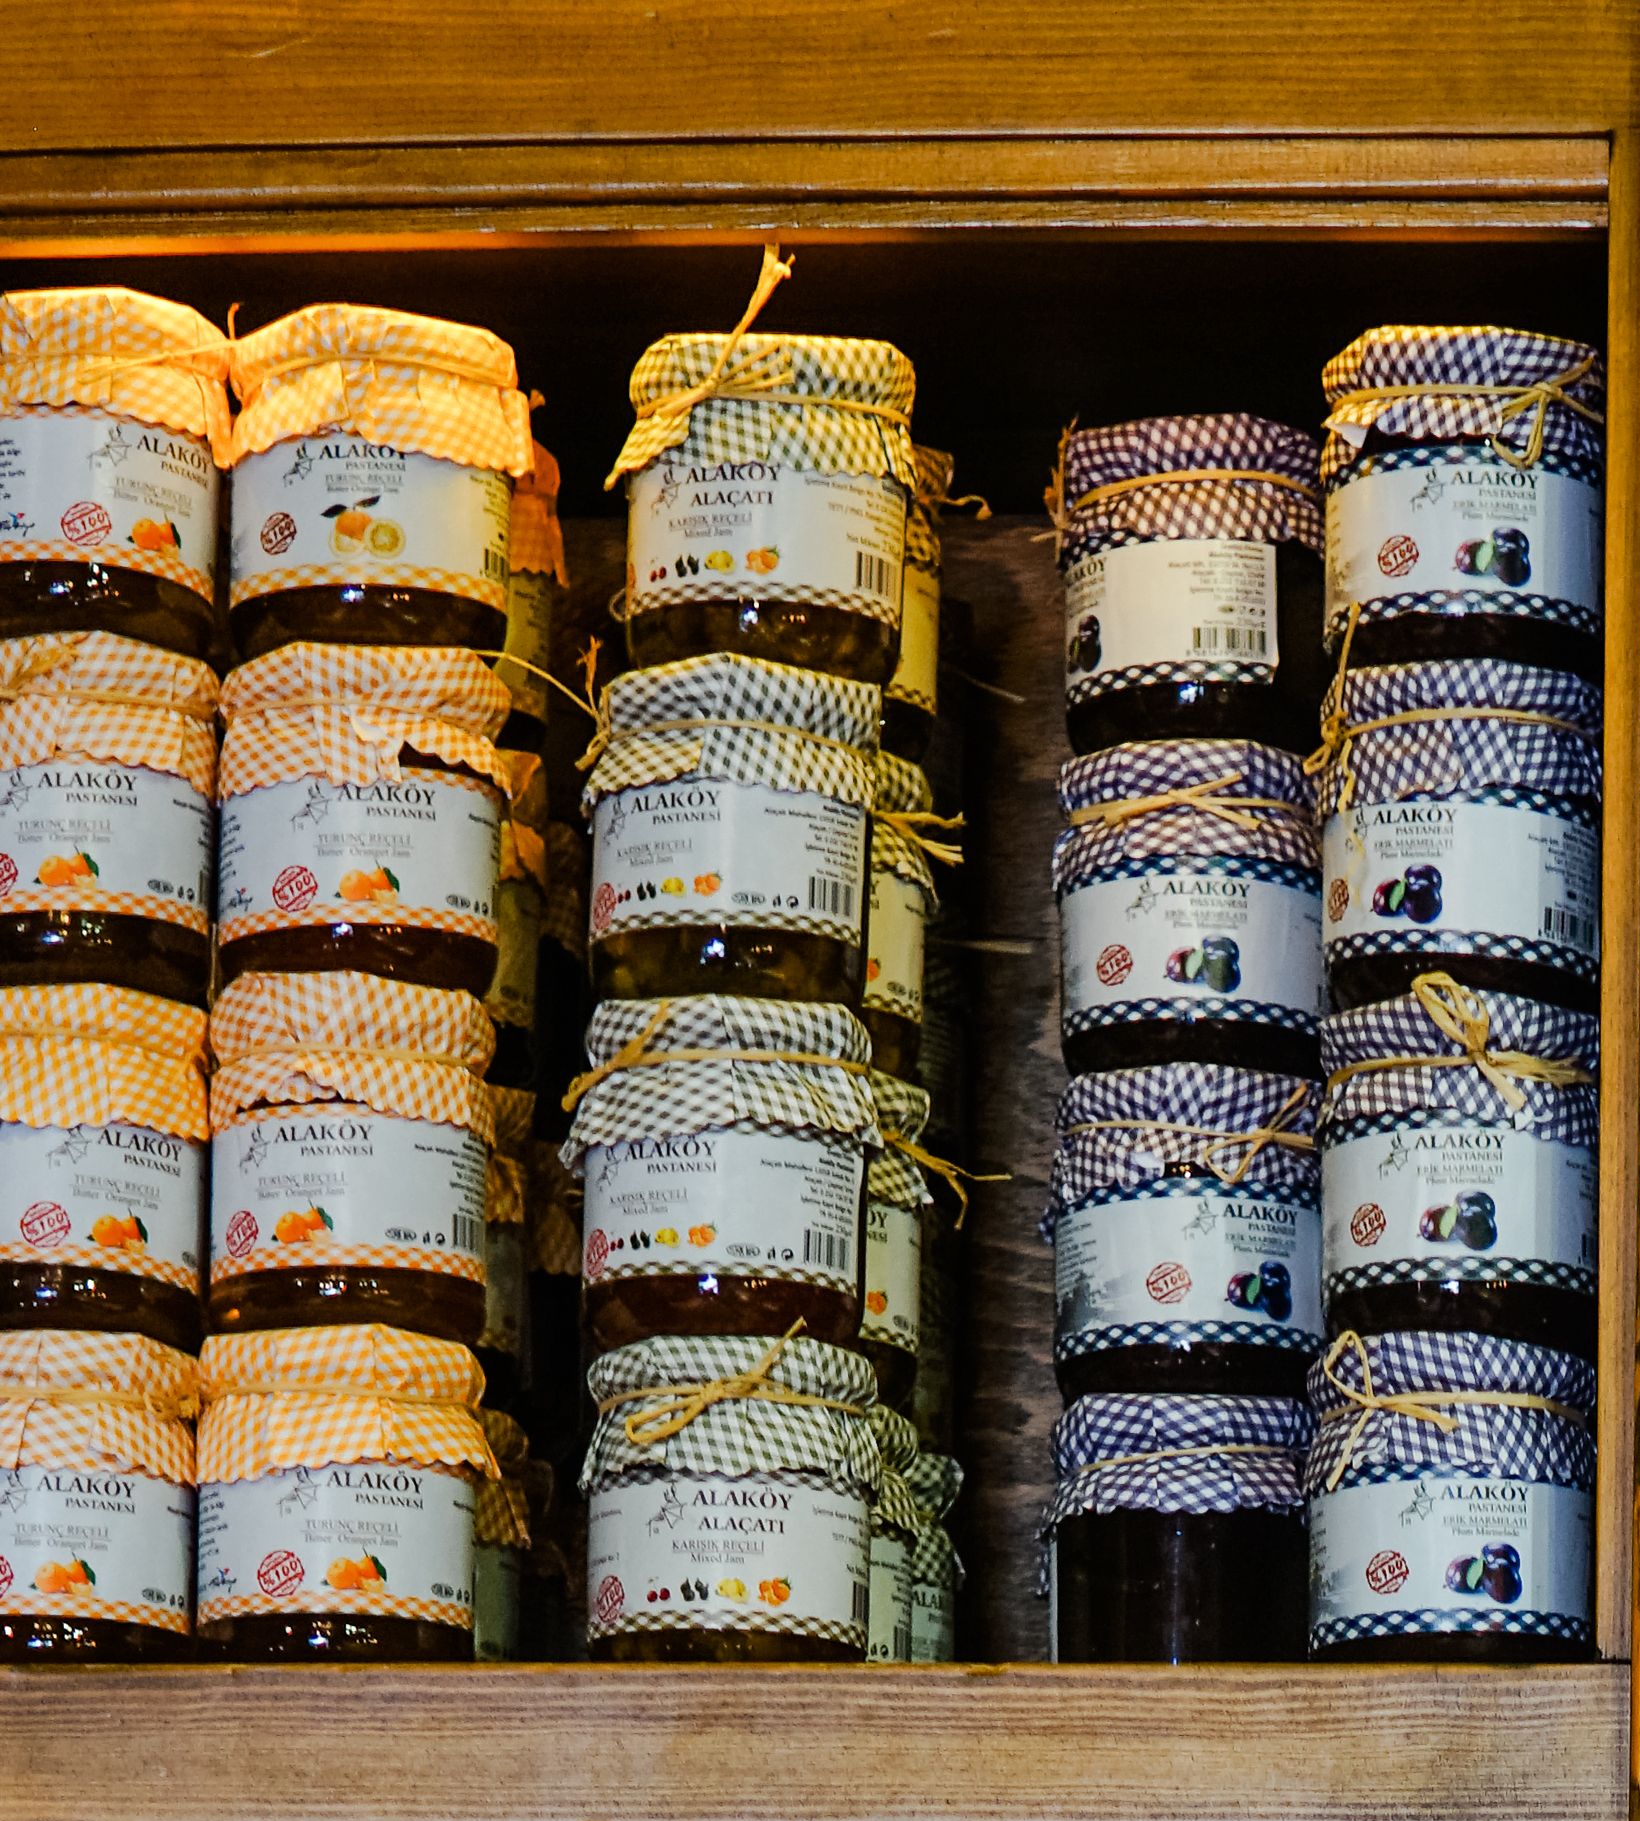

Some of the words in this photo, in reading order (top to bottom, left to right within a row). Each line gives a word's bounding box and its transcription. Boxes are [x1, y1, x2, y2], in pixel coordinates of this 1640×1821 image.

[691, 491, 773, 507] ALAÇATI
[631, 787, 720, 812] ALAKÖY
[652, 811, 721, 824] PASTANESİ
[1374, 805, 1456, 825] ALAKÖY
[1164, 879, 1250, 898] ALAKÖY
[274, 1120, 373, 1143] ALAKÖY
[300, 1144, 373, 1157] PASTANESİ
[1415, 1132, 1504, 1151] ALAKÖY
[327, 1473, 423, 1499] ALAKÖY
[1440, 1481, 1528, 1502] ALAKÖY
[355, 1492, 424, 1510] PASTANESİ
[693, 1483, 792, 1511] ALAKÖY
[699, 1516, 784, 1534] ALAÇATI
